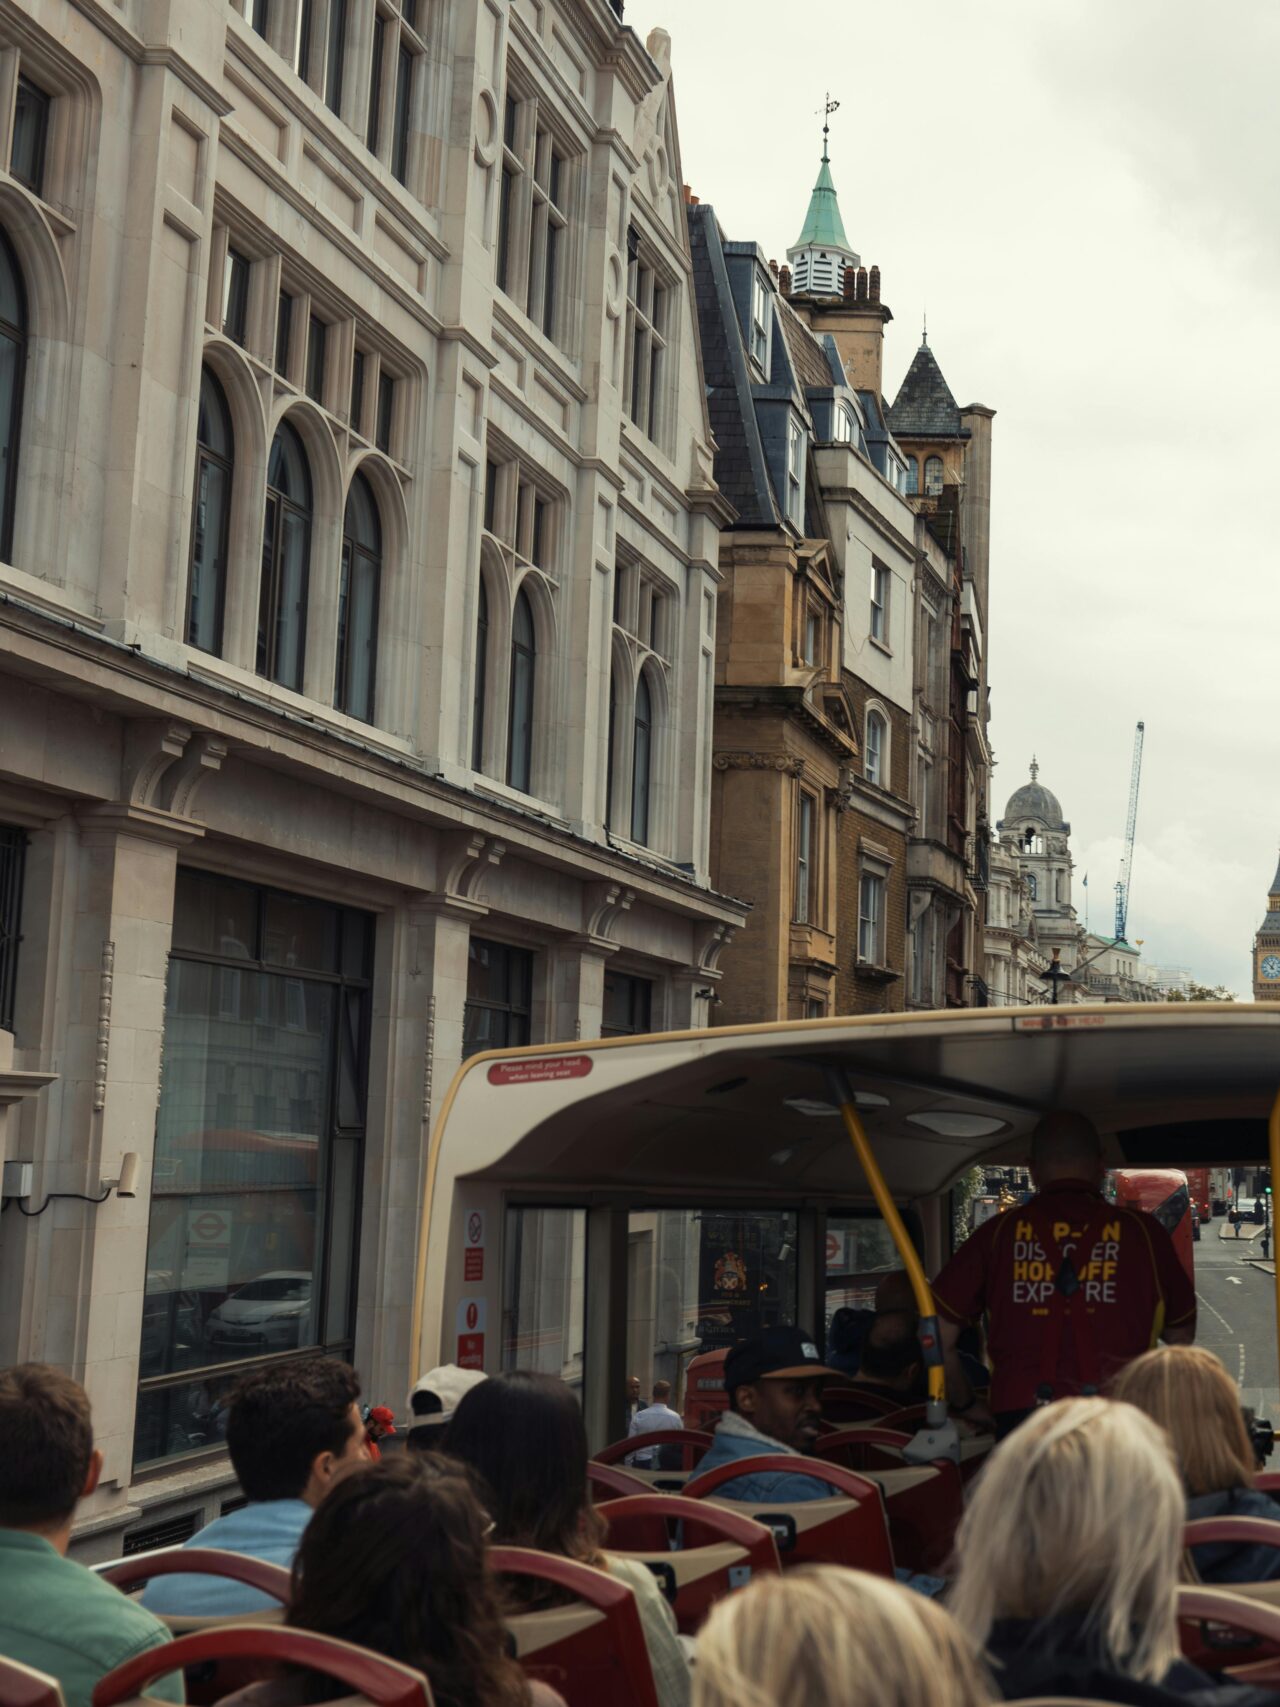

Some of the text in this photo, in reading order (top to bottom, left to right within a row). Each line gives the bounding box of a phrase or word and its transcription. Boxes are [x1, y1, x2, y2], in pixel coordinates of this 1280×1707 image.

[544, 1061, 561, 1071] your
[1015, 1220, 1120, 1242] HP-N
[1013, 1281, 1117, 1303] EXPRE
